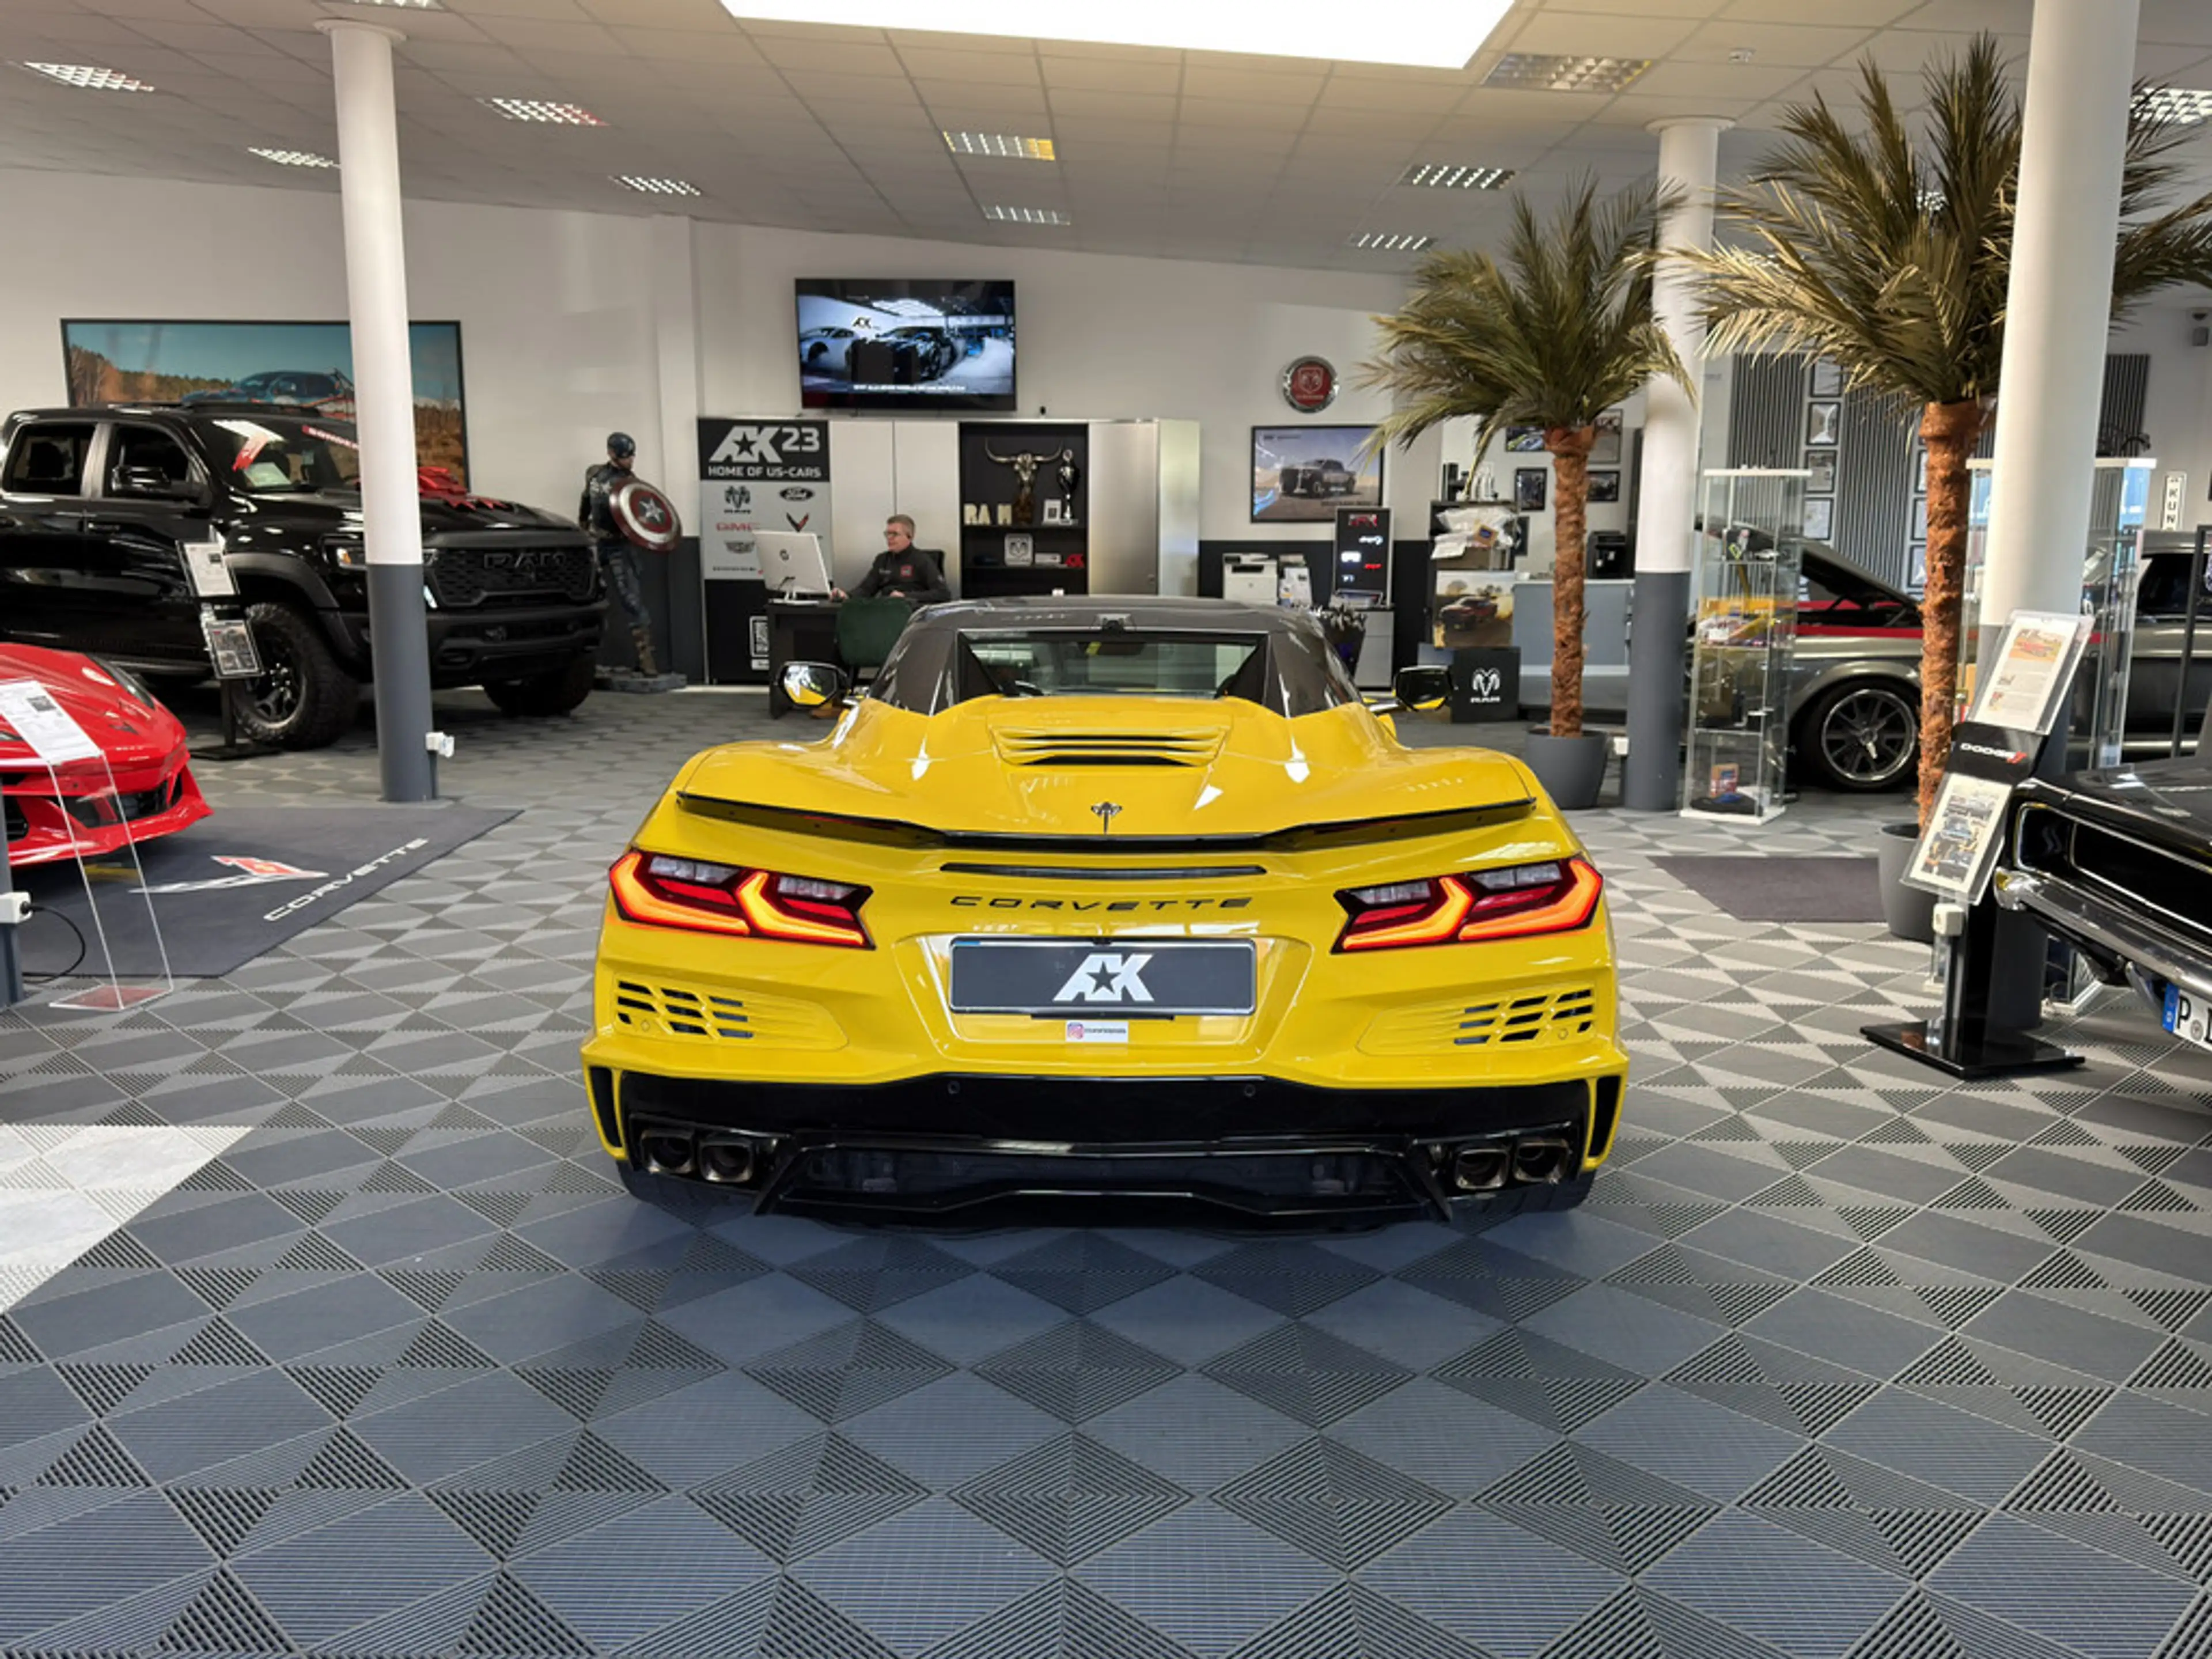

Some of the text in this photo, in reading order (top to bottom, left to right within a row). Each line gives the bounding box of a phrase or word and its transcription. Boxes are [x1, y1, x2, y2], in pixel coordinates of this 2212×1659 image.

[782, 426, 820, 452] 23
[709, 465, 821, 478] HOME OF US-CARS
[263, 838, 429, 921] CORVETTE
[950, 896, 1253, 911] CORVETTE
